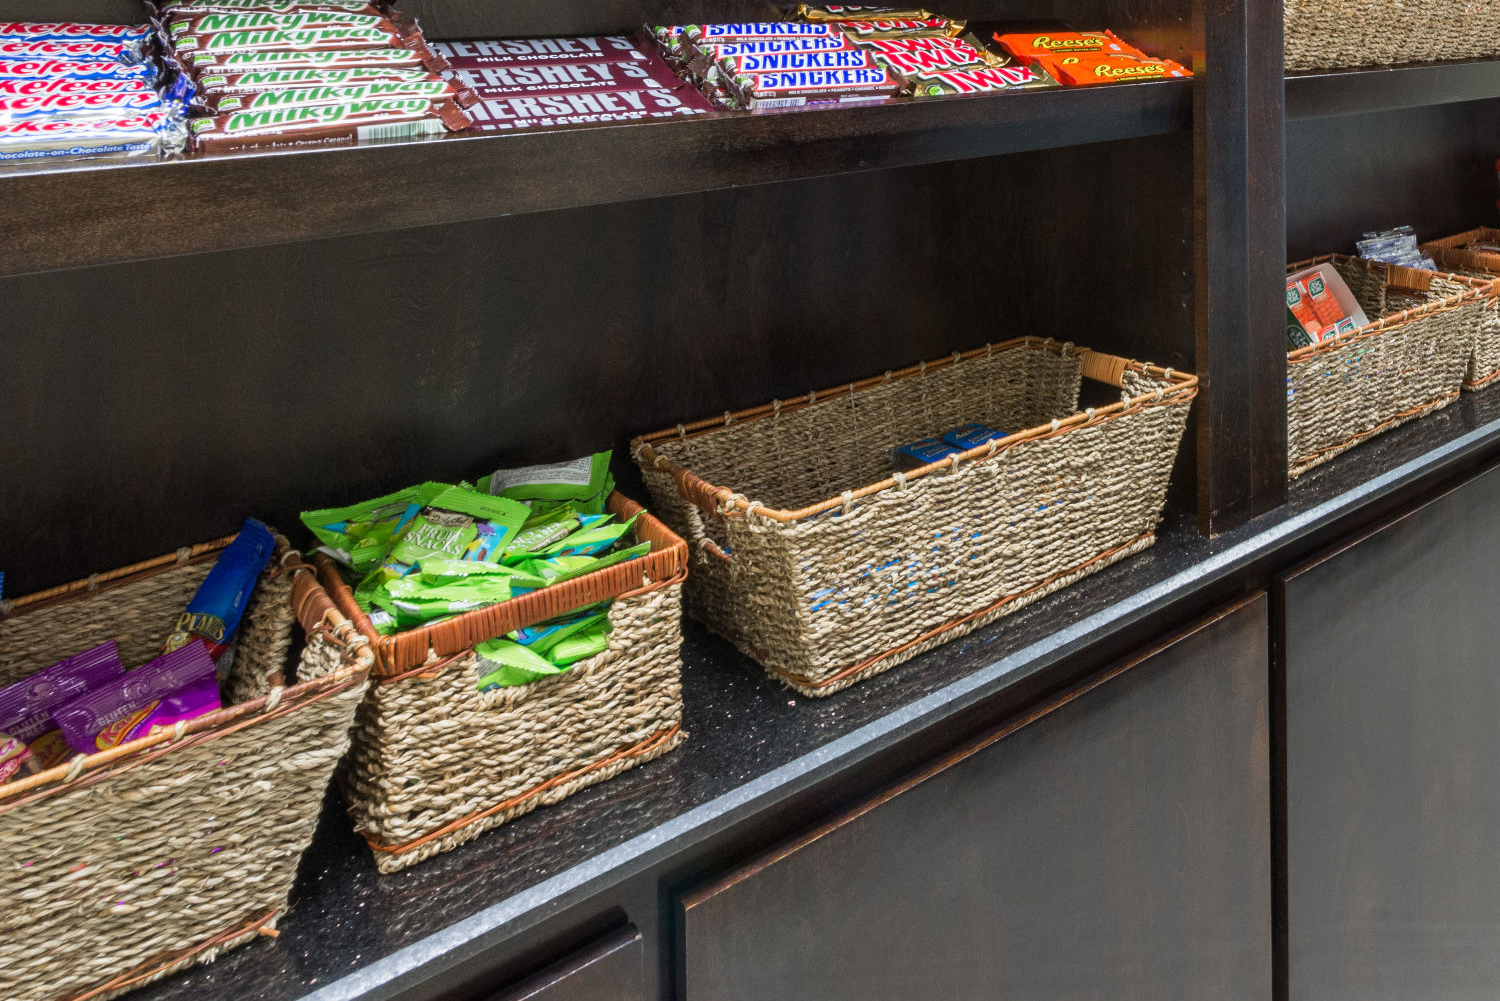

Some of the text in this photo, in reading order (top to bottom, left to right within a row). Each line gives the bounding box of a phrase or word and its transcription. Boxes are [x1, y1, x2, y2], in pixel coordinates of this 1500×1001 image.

[709, 23, 829, 38] SNICKERS
[0, 41, 124, 57] eteers
[1032, 35, 1104, 49] Reese's
[517, 52, 605, 61] CHOCOLATE
[744, 50, 865, 71] SNICKERS
[872, 47, 986, 76] TWIX
[440, 61, 650, 89] ERSHEY'S
[762, 67, 886, 88] SNICKERS
[919, 65, 1043, 94] TWIX
[1094, 63, 1166, 77] Reese's
[250, 84, 366, 110] Milky
[484, 80, 617, 94] MILK CHOCOLATE
[225, 98, 431, 133] Milky Way
[417, 523, 465, 543] FRUIT
[403, 532, 464, 556] SNACKS
[98, 702, 137, 726] GLUTEN
